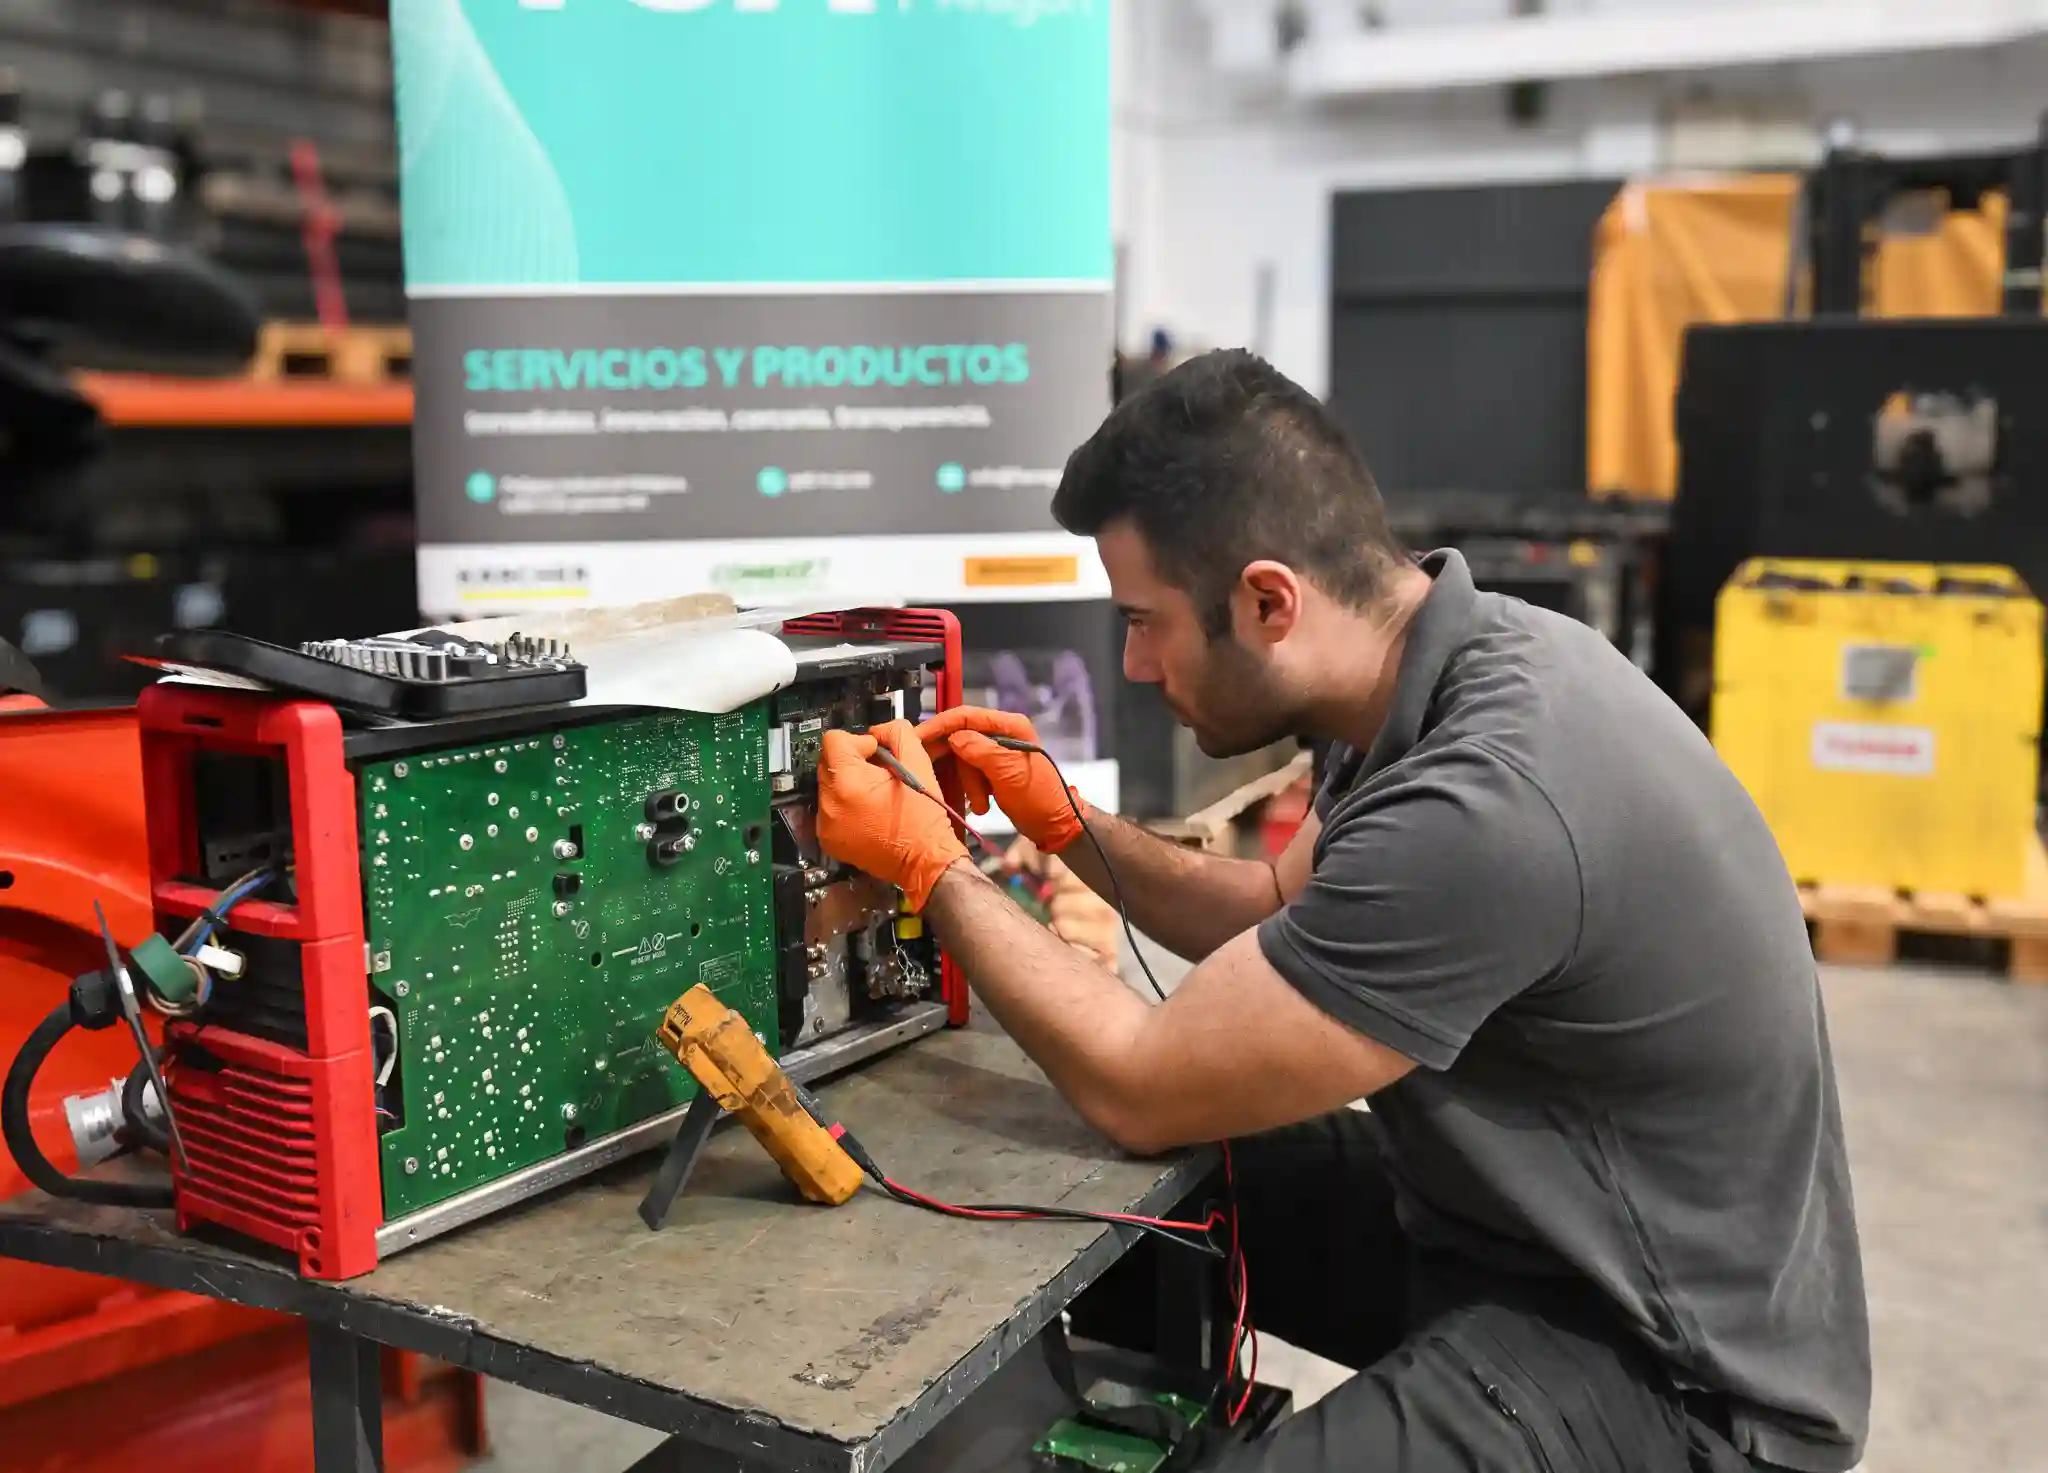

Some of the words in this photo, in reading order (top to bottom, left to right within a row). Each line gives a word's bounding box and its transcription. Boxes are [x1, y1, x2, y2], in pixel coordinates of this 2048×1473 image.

[464, 347, 708, 391] SERVICIOS
[713, 347, 745, 388] Y
[752, 343, 1030, 388] PRODUCTOS
